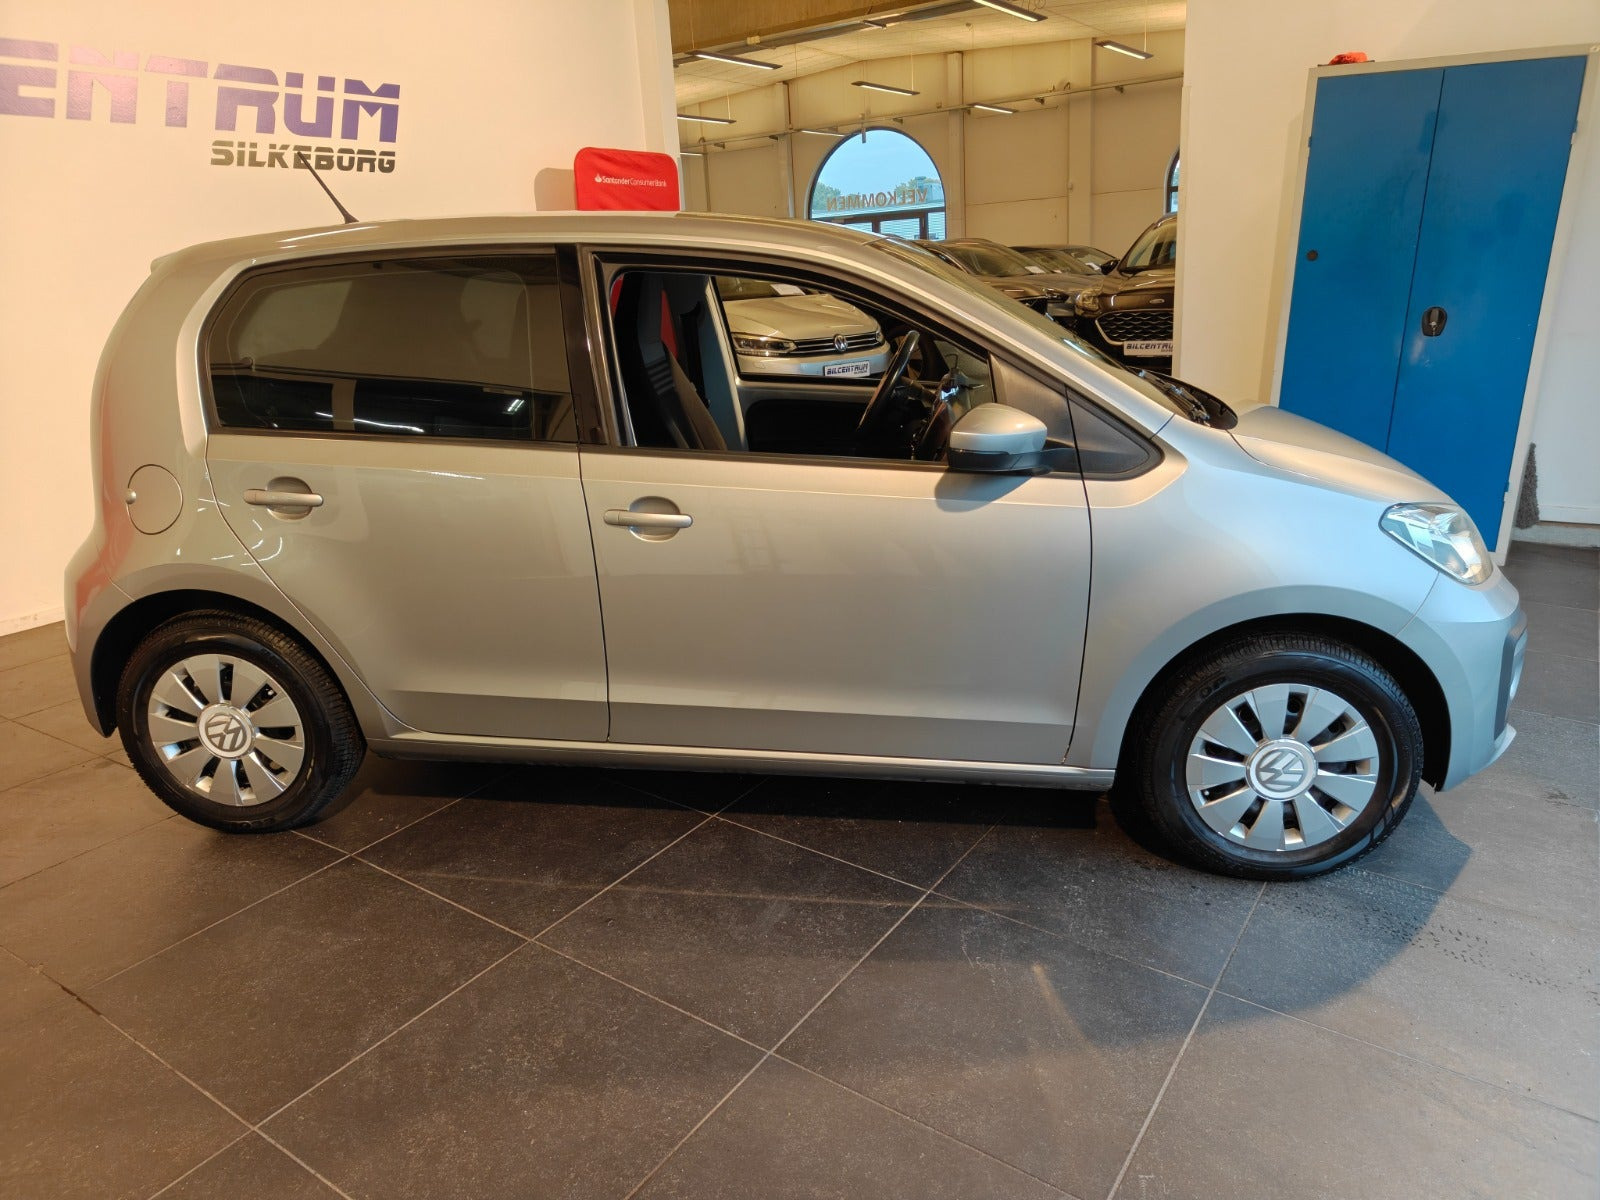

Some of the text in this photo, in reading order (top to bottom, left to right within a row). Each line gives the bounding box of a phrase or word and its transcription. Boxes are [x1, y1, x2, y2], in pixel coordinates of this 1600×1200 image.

[210, 139, 396, 174] SILKEBORG
[602, 175, 630, 185] Santander
[1126, 342, 1174, 350] BILCENTRU
[826, 363, 869, 375] BILCENTRUM
